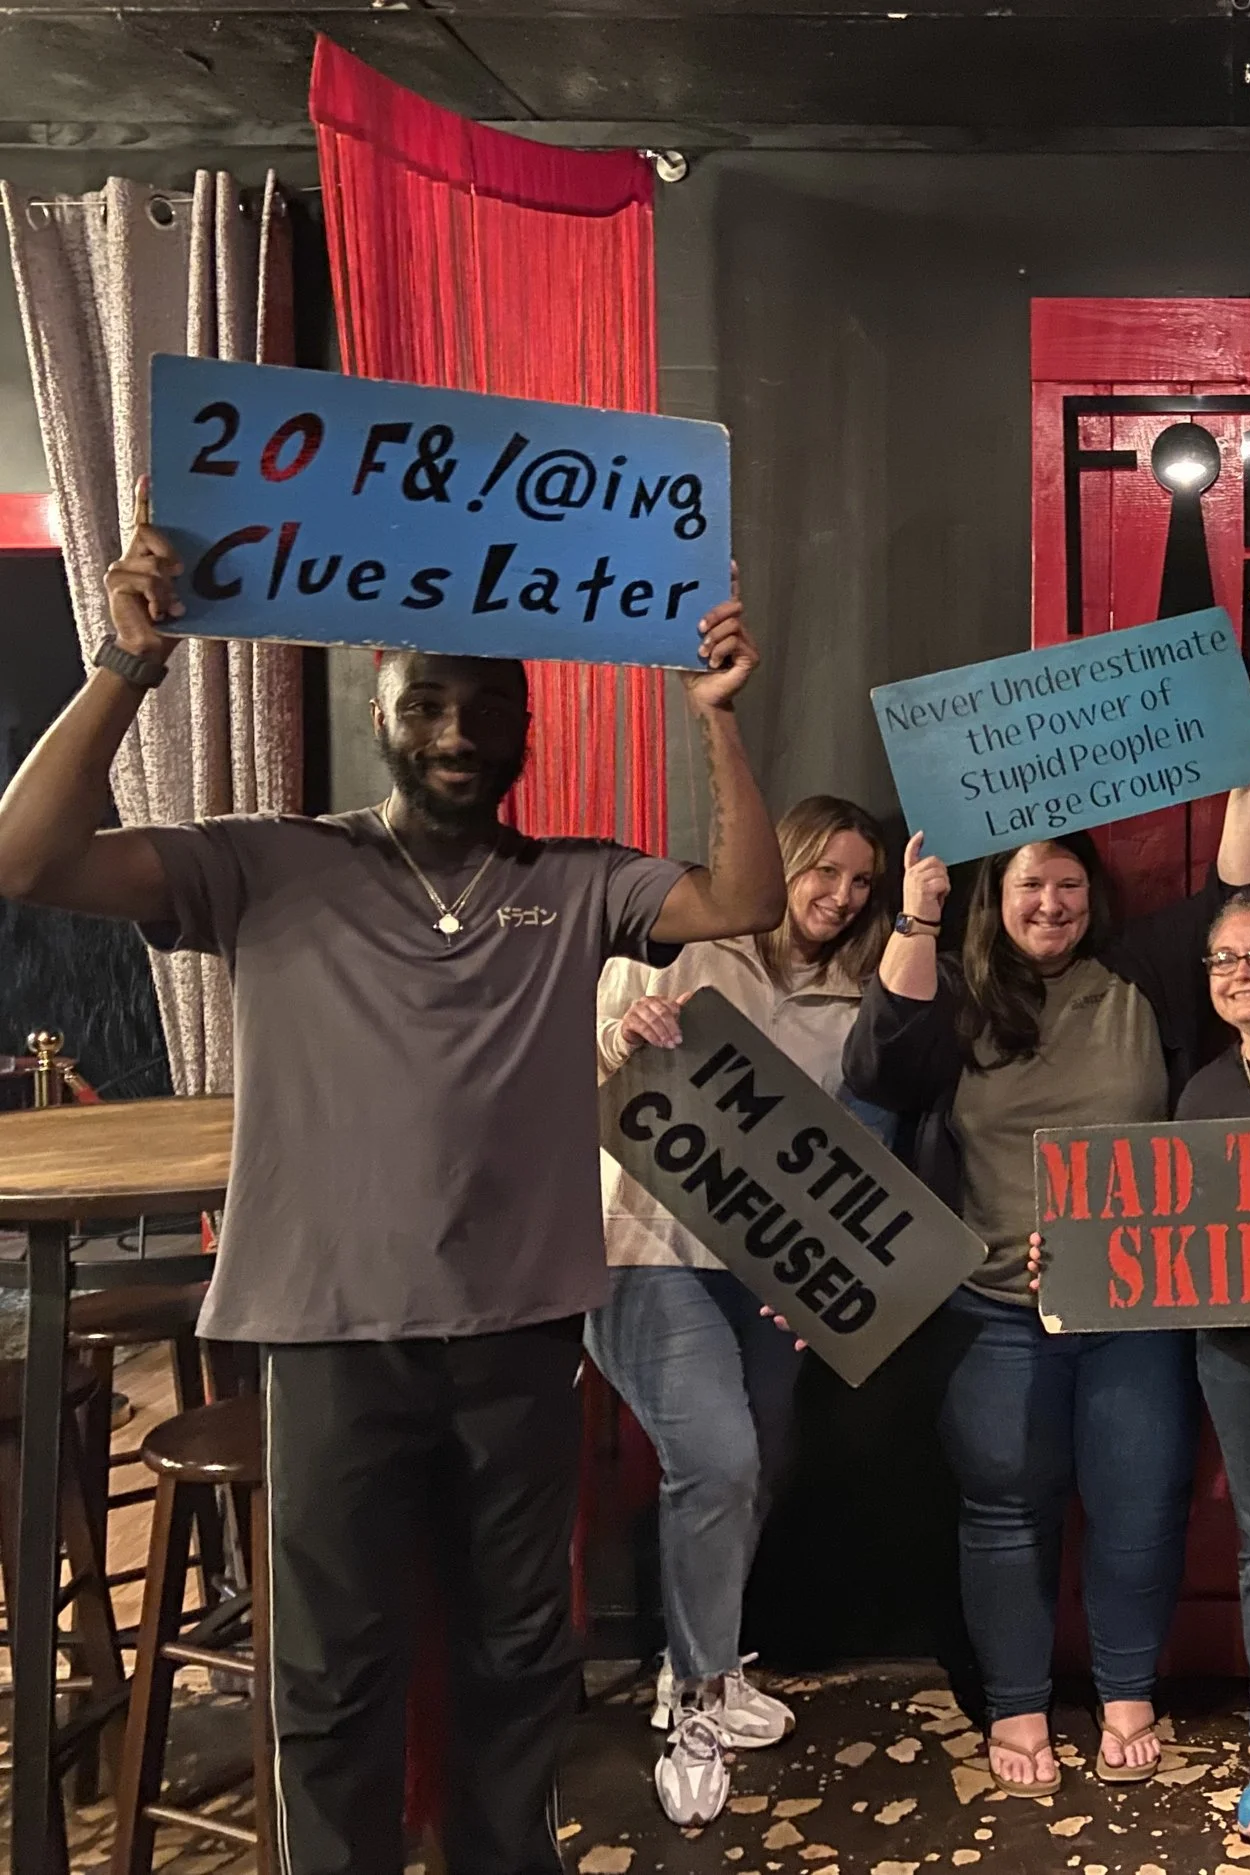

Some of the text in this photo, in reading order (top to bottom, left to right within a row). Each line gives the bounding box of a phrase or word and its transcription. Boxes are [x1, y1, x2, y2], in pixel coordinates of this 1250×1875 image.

[190, 401, 325, 483] 20
[193, 522, 699, 622] Clues Later
[885, 686, 985, 733] Never
[991, 627, 1229, 706] Underestimate
[967, 677, 1173, 755] the Power of
[960, 715, 1204, 801] Stupid People in
[985, 760, 1202, 837] Large Groups
[497, 906, 557, 927] ドラゴン
[689, 1042, 914, 1267] I'M STILL
[1039, 1136, 1193, 1222] MAD
[619, 1091, 877, 1335] CONFUSED
